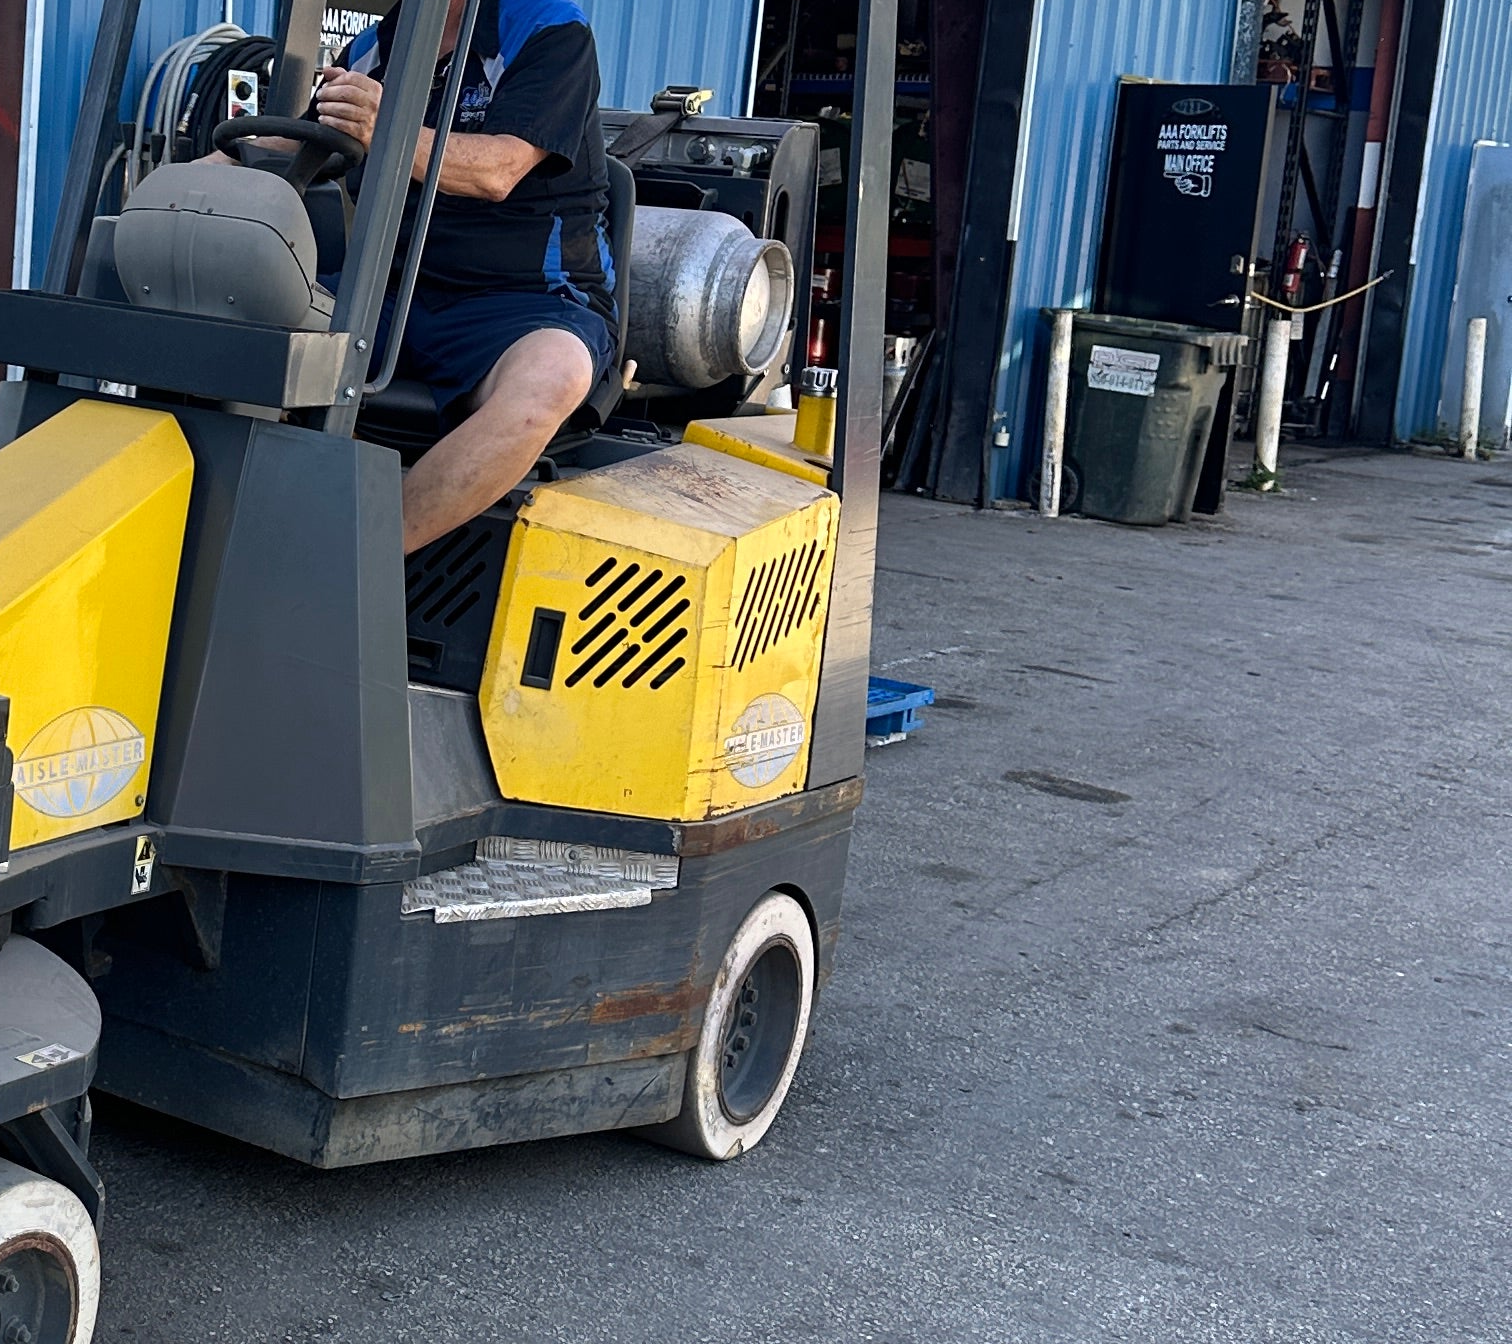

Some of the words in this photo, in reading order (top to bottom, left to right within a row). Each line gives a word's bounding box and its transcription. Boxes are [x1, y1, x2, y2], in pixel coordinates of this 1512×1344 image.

[1159, 124, 1178, 139] AAA
[1178, 124, 1228, 140] FORKLIFTS
[1157, 140, 1180, 150] PARTS
[1180, 140, 1196, 150] AND
[1195, 140, 1227, 151] SERVICE
[1164, 154, 1186, 172] MAIN
[1185, 155, 1216, 173] OFFICE
[17, 740, 143, 785] AISLE-MASTER
